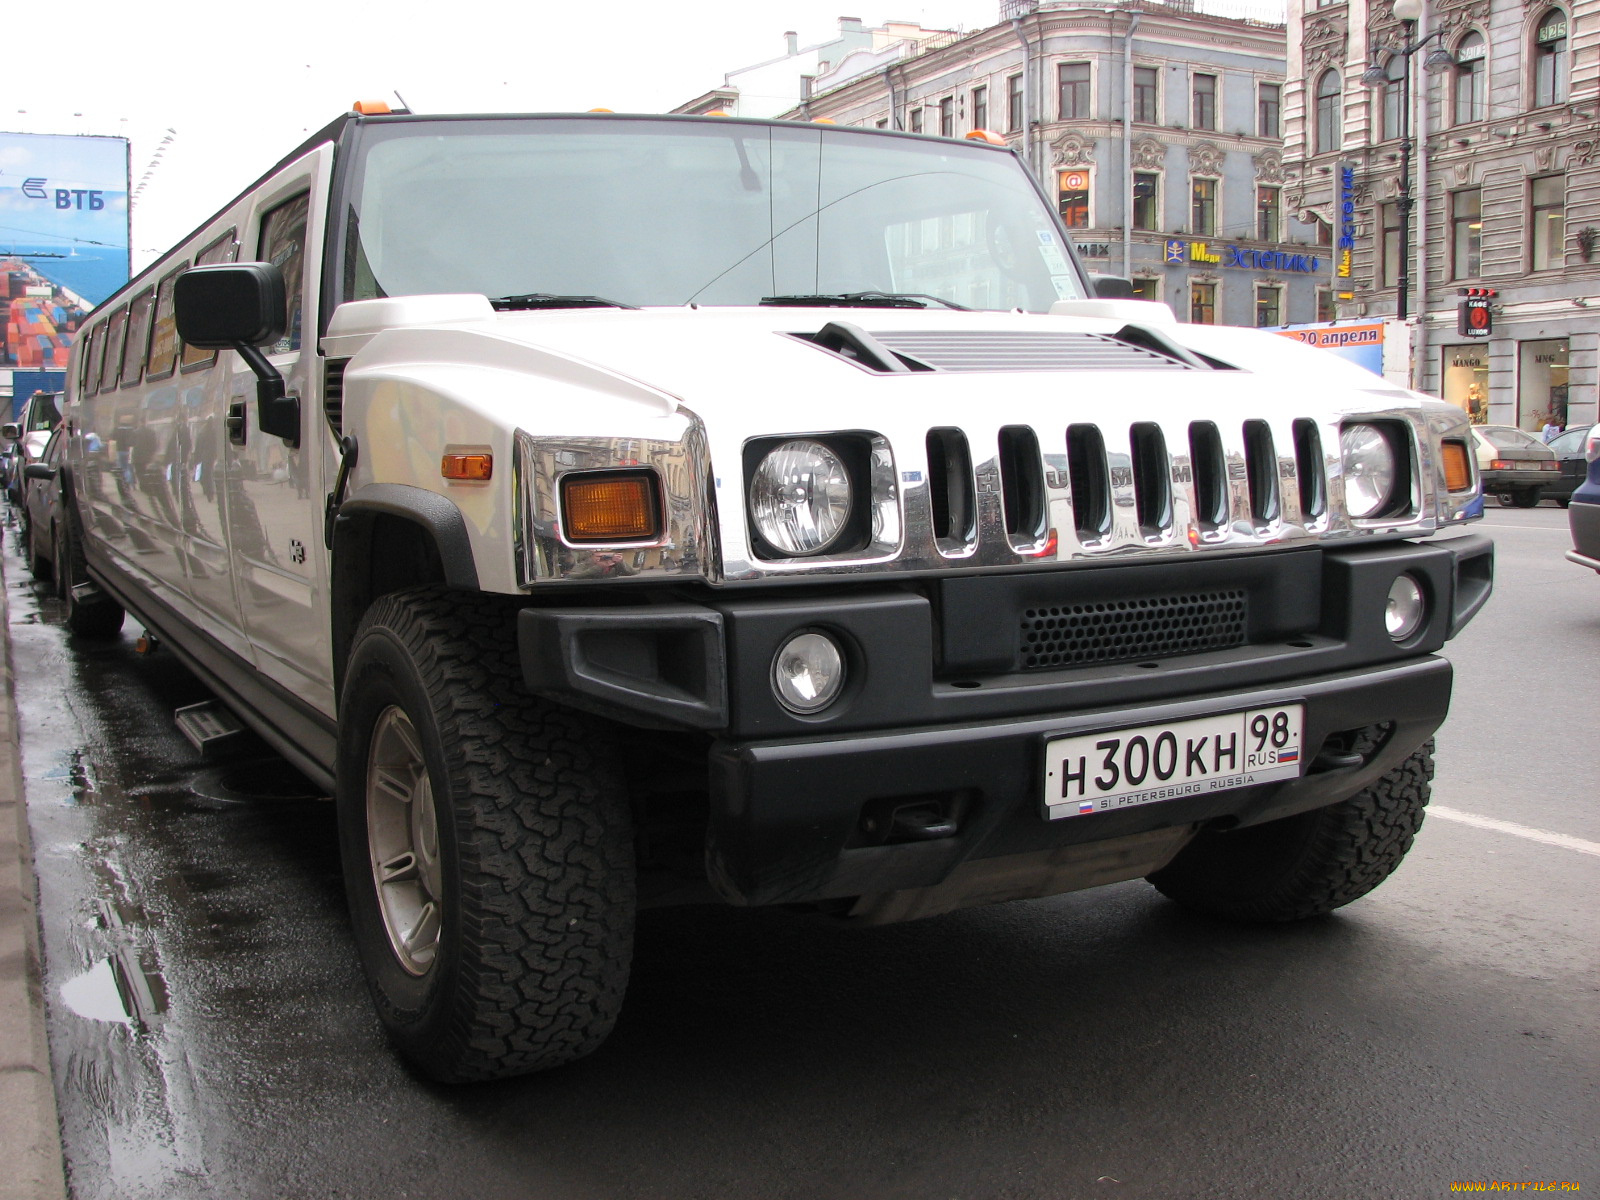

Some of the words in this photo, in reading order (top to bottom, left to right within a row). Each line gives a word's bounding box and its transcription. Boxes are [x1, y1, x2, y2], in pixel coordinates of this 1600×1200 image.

[1540, 22, 1566, 41] 325
[55, 189, 105, 211] ВТБ
[1190, 242, 1221, 264] Меди
[1468, 300, 1487, 308] КАФЕ
[1300, 332, 1317, 345] 20
[1321, 330, 1377, 347] апреля
[1467, 328, 1488, 336] LUXOR
[1452, 358, 1480, 368] MANGO
[976, 461, 1297, 493] HUMMER
[1250, 711, 1289, 752] 98
[1247, 750, 1277, 768] RUS
[1118, 783, 1201, 806] PETERSBURG
[1209, 775, 1255, 790] RUSSIA
